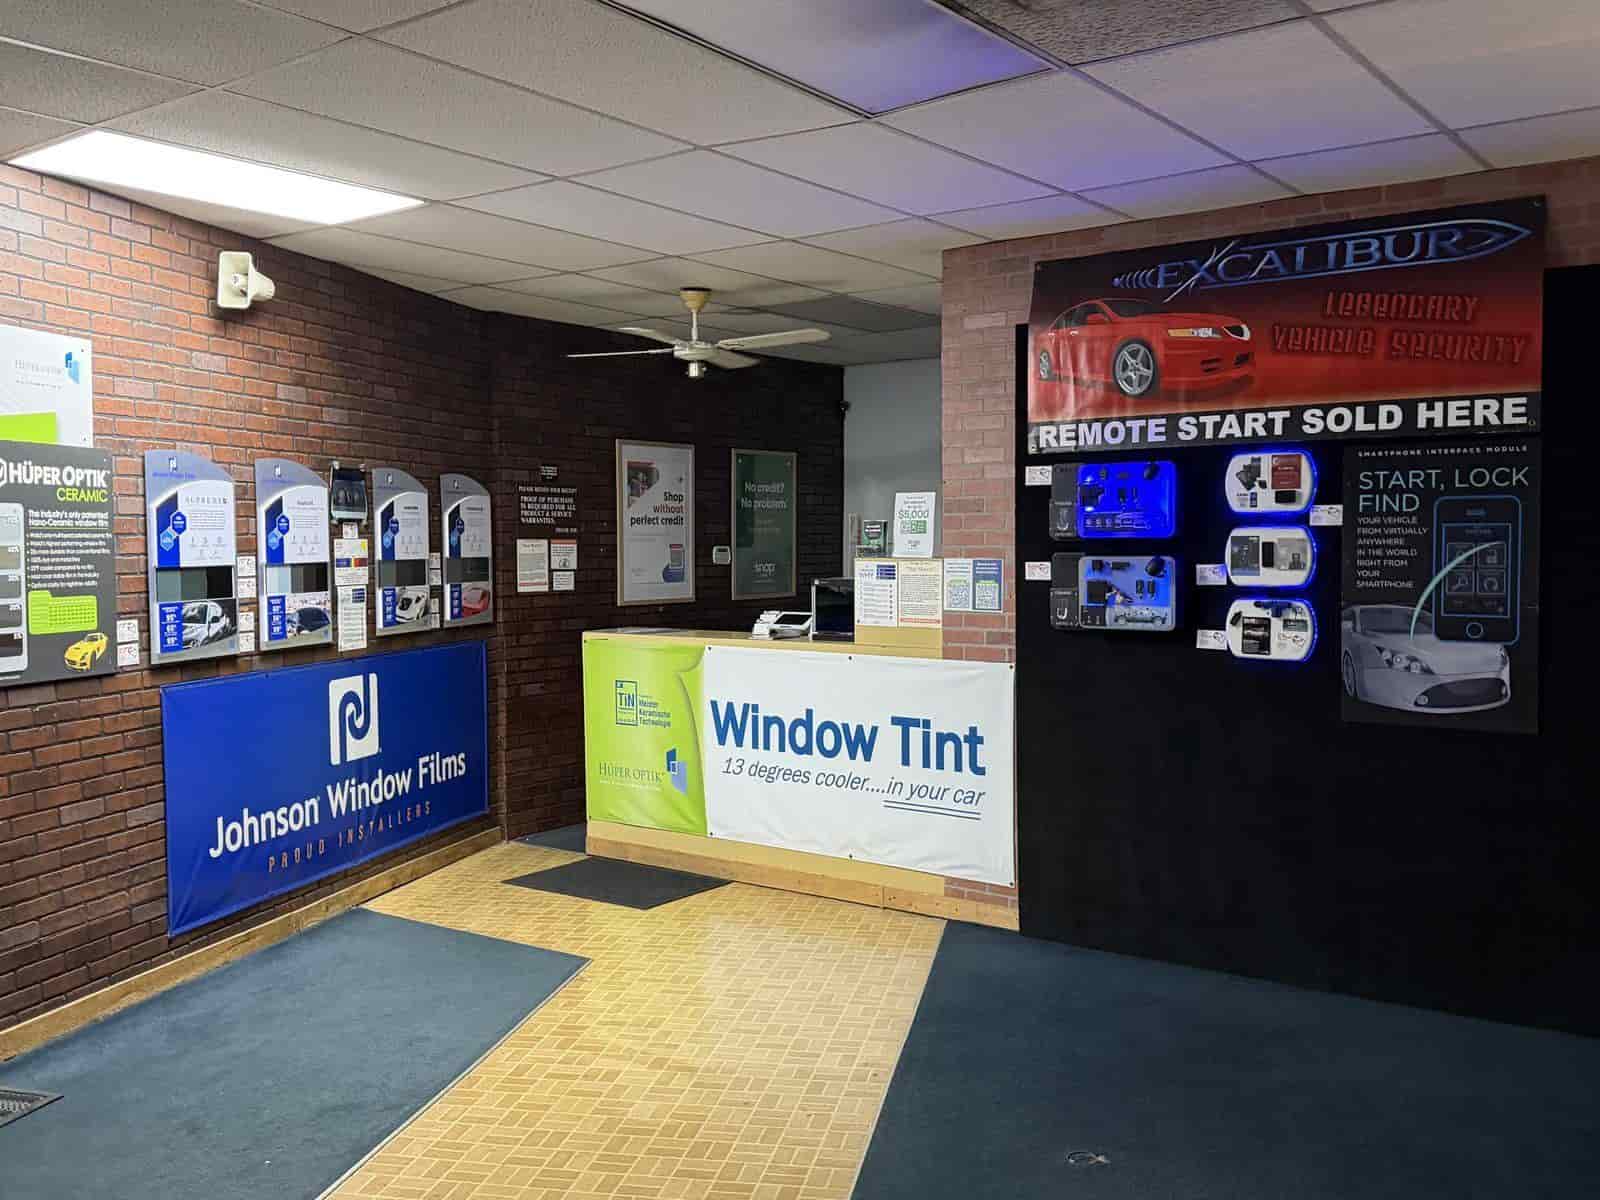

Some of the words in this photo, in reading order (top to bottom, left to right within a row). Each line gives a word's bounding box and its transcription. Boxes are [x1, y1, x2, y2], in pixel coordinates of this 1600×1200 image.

[1157, 227, 1470, 296] EXCALIBUR
[1039, 419, 1167, 449] REMOTE
[1177, 411, 1290, 440] START
[1302, 404, 1403, 433] SOLD
[1418, 397, 1528, 427] HERE
[1427, 447, 1481, 455] INTERFACE
[1487, 445, 1527, 453] MODULE
[9, 460, 62, 485] HÜPER
[62, 465, 108, 488] OPTIK
[1359, 469, 1444, 491] START,
[1455, 466, 1529, 487] LOCK
[56, 487, 108, 502] CERAMIC
[664, 491, 684, 503] Shop
[1359, 493, 1420, 512] FIND
[653, 503, 684, 514] without
[897, 510, 929, 521] $5,000
[630, 515, 660, 528] perfect
[661, 514, 684, 526] credit
[1357, 516, 1381, 524] YOUR
[1382, 516, 1418, 524] VEHICLE
[1357, 527, 1382, 535] FROM
[1383, 527, 1429, 535] VIRTUALLY
[1357, 538, 1405, 546] ANYWHERE
[710, 699, 879, 762] Window
[890, 716, 986, 776] Tint
[599, 761, 631, 777] HÜPER
[632, 768, 663, 783] OPTIK
[721, 757, 745, 775] 13
[748, 760, 810, 784] degrees
[906, 782, 950, 800] your
[953, 788, 986, 806] car
[209, 796, 320, 858] Johnson
[326, 768, 412, 818] Window
[418, 752, 466, 789] Films
[268, 839, 326, 872] PROUD
[338, 801, 432, 848] INSTALLERS
